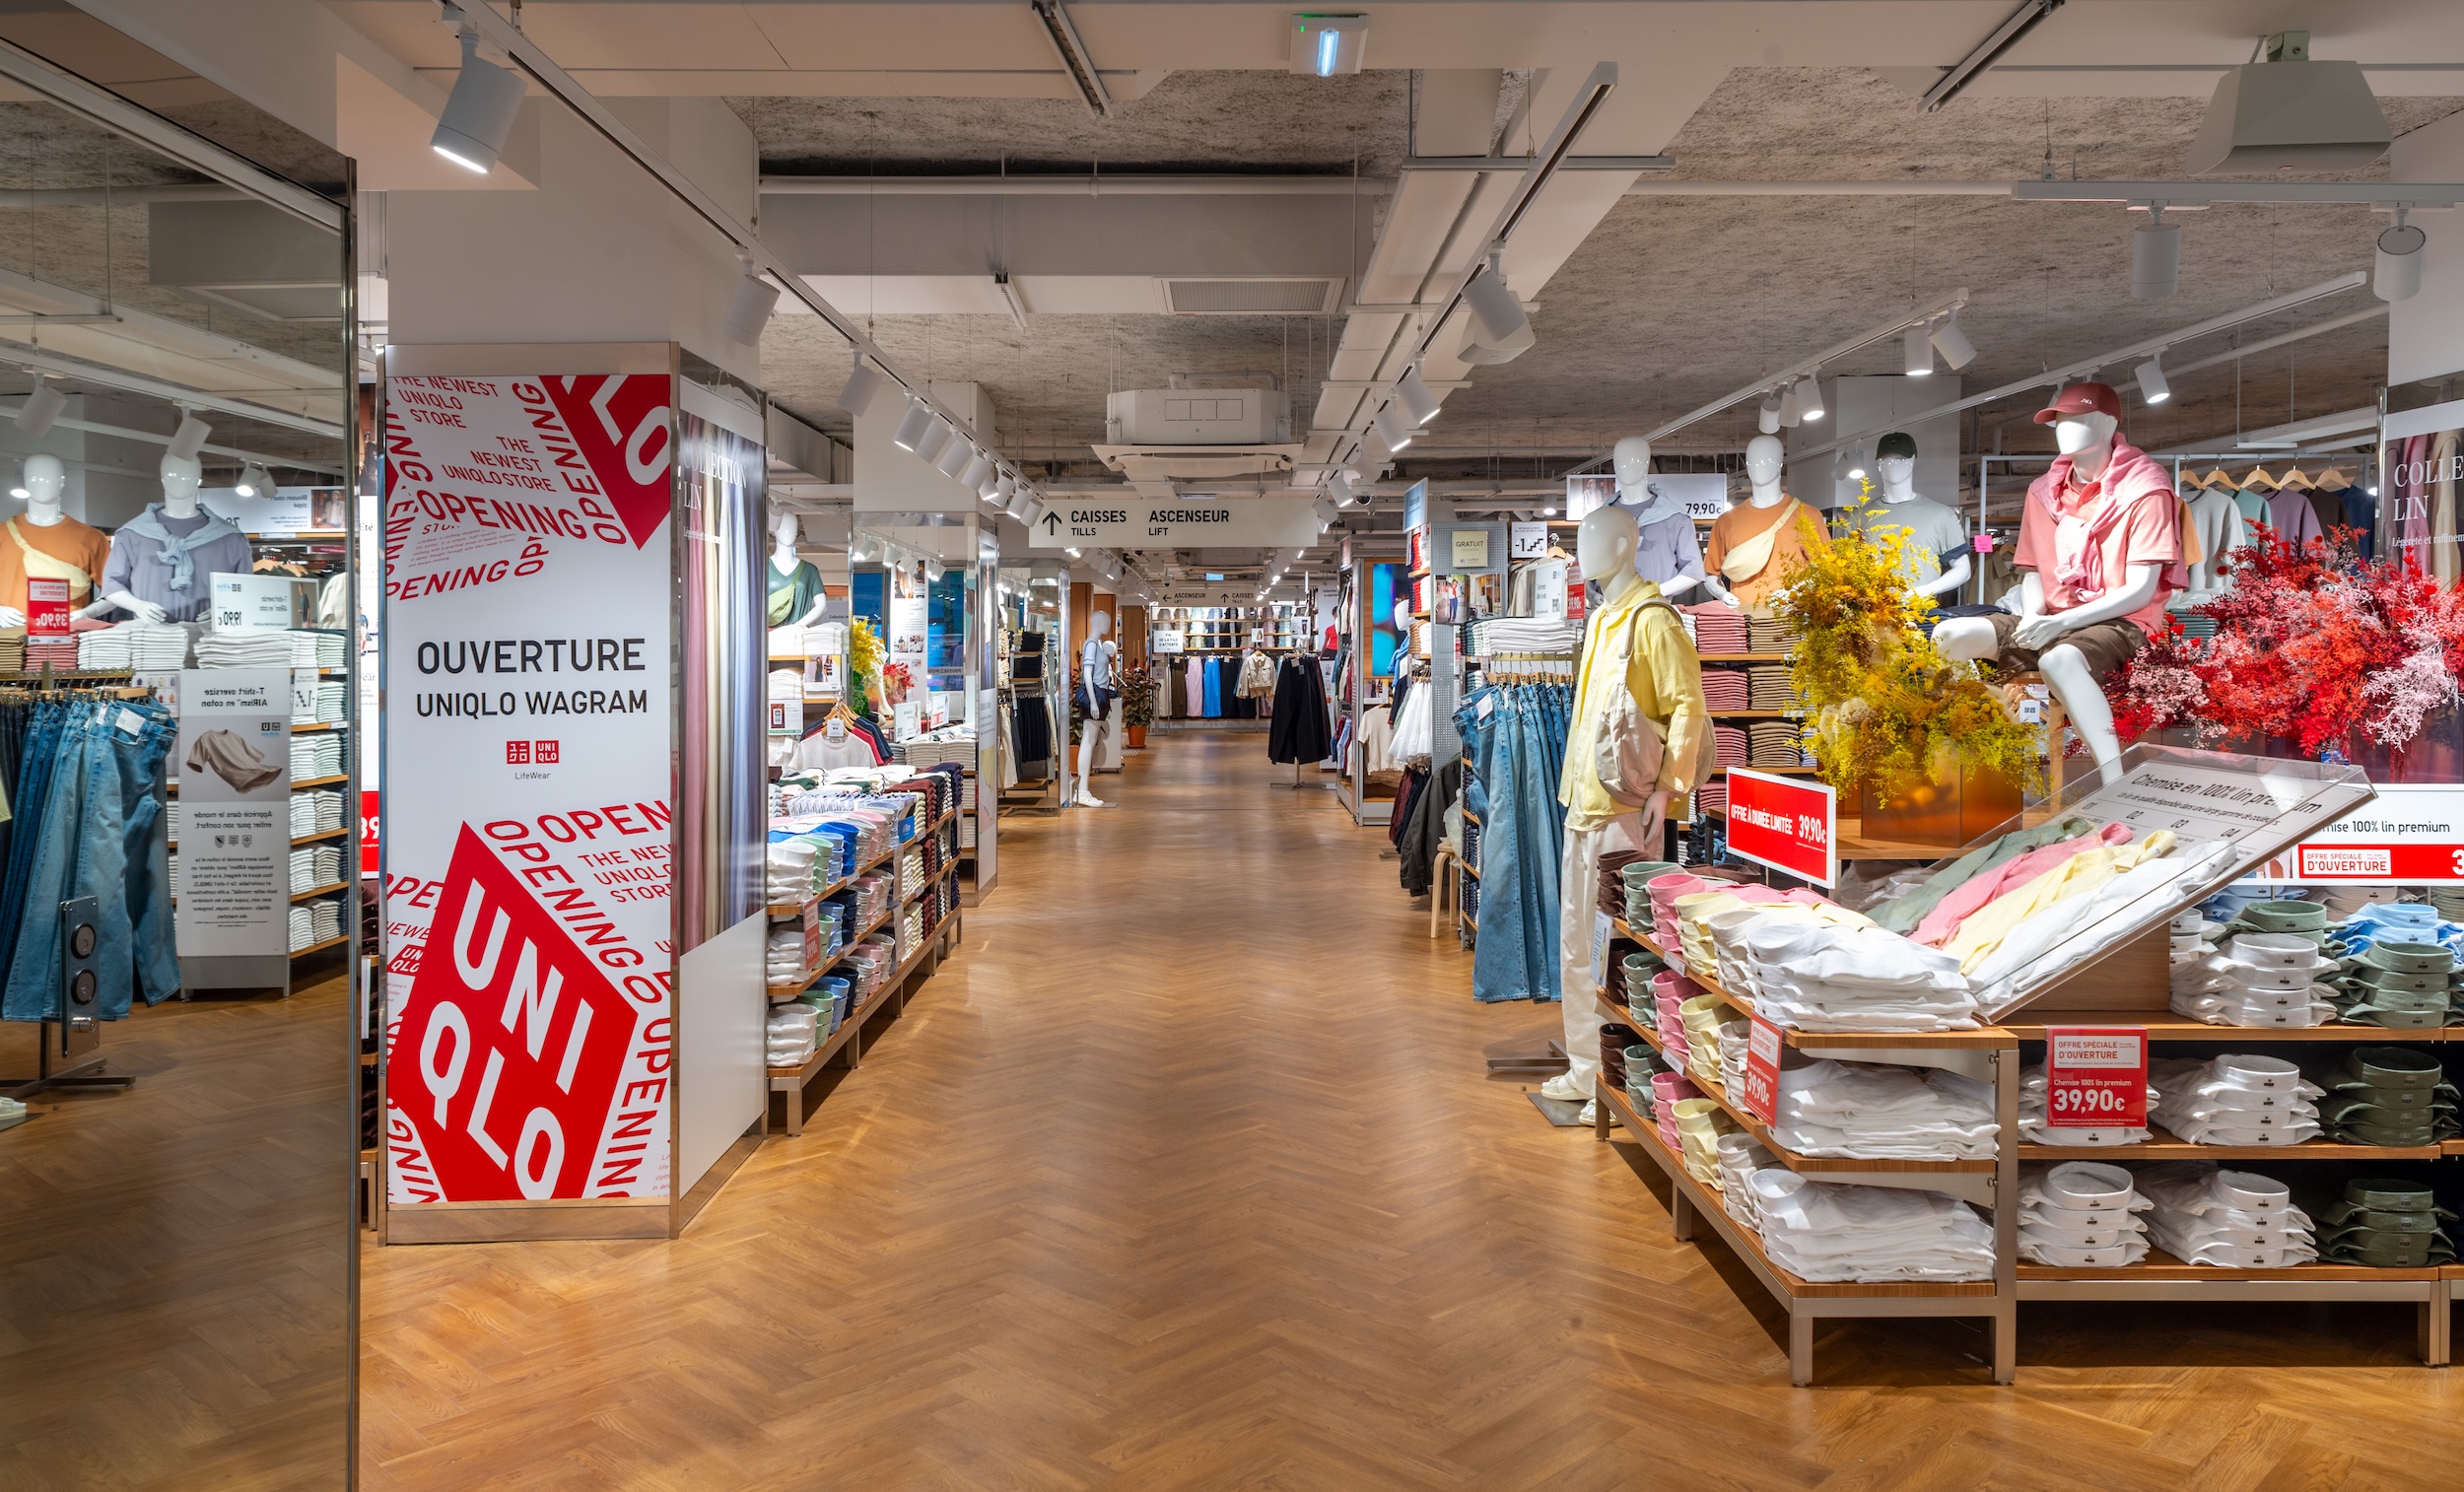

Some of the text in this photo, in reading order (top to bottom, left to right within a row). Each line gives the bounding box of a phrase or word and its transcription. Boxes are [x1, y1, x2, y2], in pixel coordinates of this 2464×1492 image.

[427, 376, 499, 397] NEWEST
[397, 389, 463, 410] UNIQLO
[410, 409, 467, 429] STORE
[496, 437, 534, 454] THE
[470, 450, 542, 473] NEWEST
[512, 382, 628, 546] OPENING
[2394, 455, 2464, 488] COLLE
[442, 464, 556, 494] UNIQLO STORE
[683, 481, 703, 510] LIN
[416, 489, 587, 540] OPENING
[1070, 509, 1230, 523] CAISSES ASCENSEUR
[1685, 503, 1722, 516] 79,90€
[2392, 495, 2430, 521] LIN
[1070, 527, 1169, 536] TILLS LIFT
[2392, 534, 2423, 548] Légèreté
[2424, 536, 2431, 545] et
[417, 639, 646, 674] OUVERTURE
[416, 690, 648, 719] UNIQLO WAGRAM
[2131, 774, 2323, 814] Chemise en 100% lin premium
[536, 800, 670, 844] OPEN
[1731, 803, 1747, 822] OFFRE
[1751, 807, 1770, 829] DURÉE
[1770, 814, 1793, 835] LIMITÉE
[1798, 814, 1826, 845] 39,90€
[2125, 810, 2145, 820] 02
[2170, 819, 2190, 828] 03
[2221, 828, 2242, 838] 04
[2352, 820, 2378, 833] 100%
[2381, 820, 2395, 833] lin
[2398, 820, 2450, 835] premium
[578, 850, 630, 867] THE
[2307, 860, 2387, 871] D'OUVERTURE
[2331, 851, 2362, 860] SPÉCIALE
[483, 820, 644, 969] OPENING
[453, 877, 594, 1095] UNI
[2059, 1051, 2118, 1059] D'OUVERTURE
[2083, 1040, 2118, 1049] SPÉCIALE
[1746, 1070, 1770, 1107] 39,90€
[2104, 1079, 2132, 1088] premium
[420, 1000, 565, 1201] QLO
[2053, 1088, 2126, 1115] 39,90€
